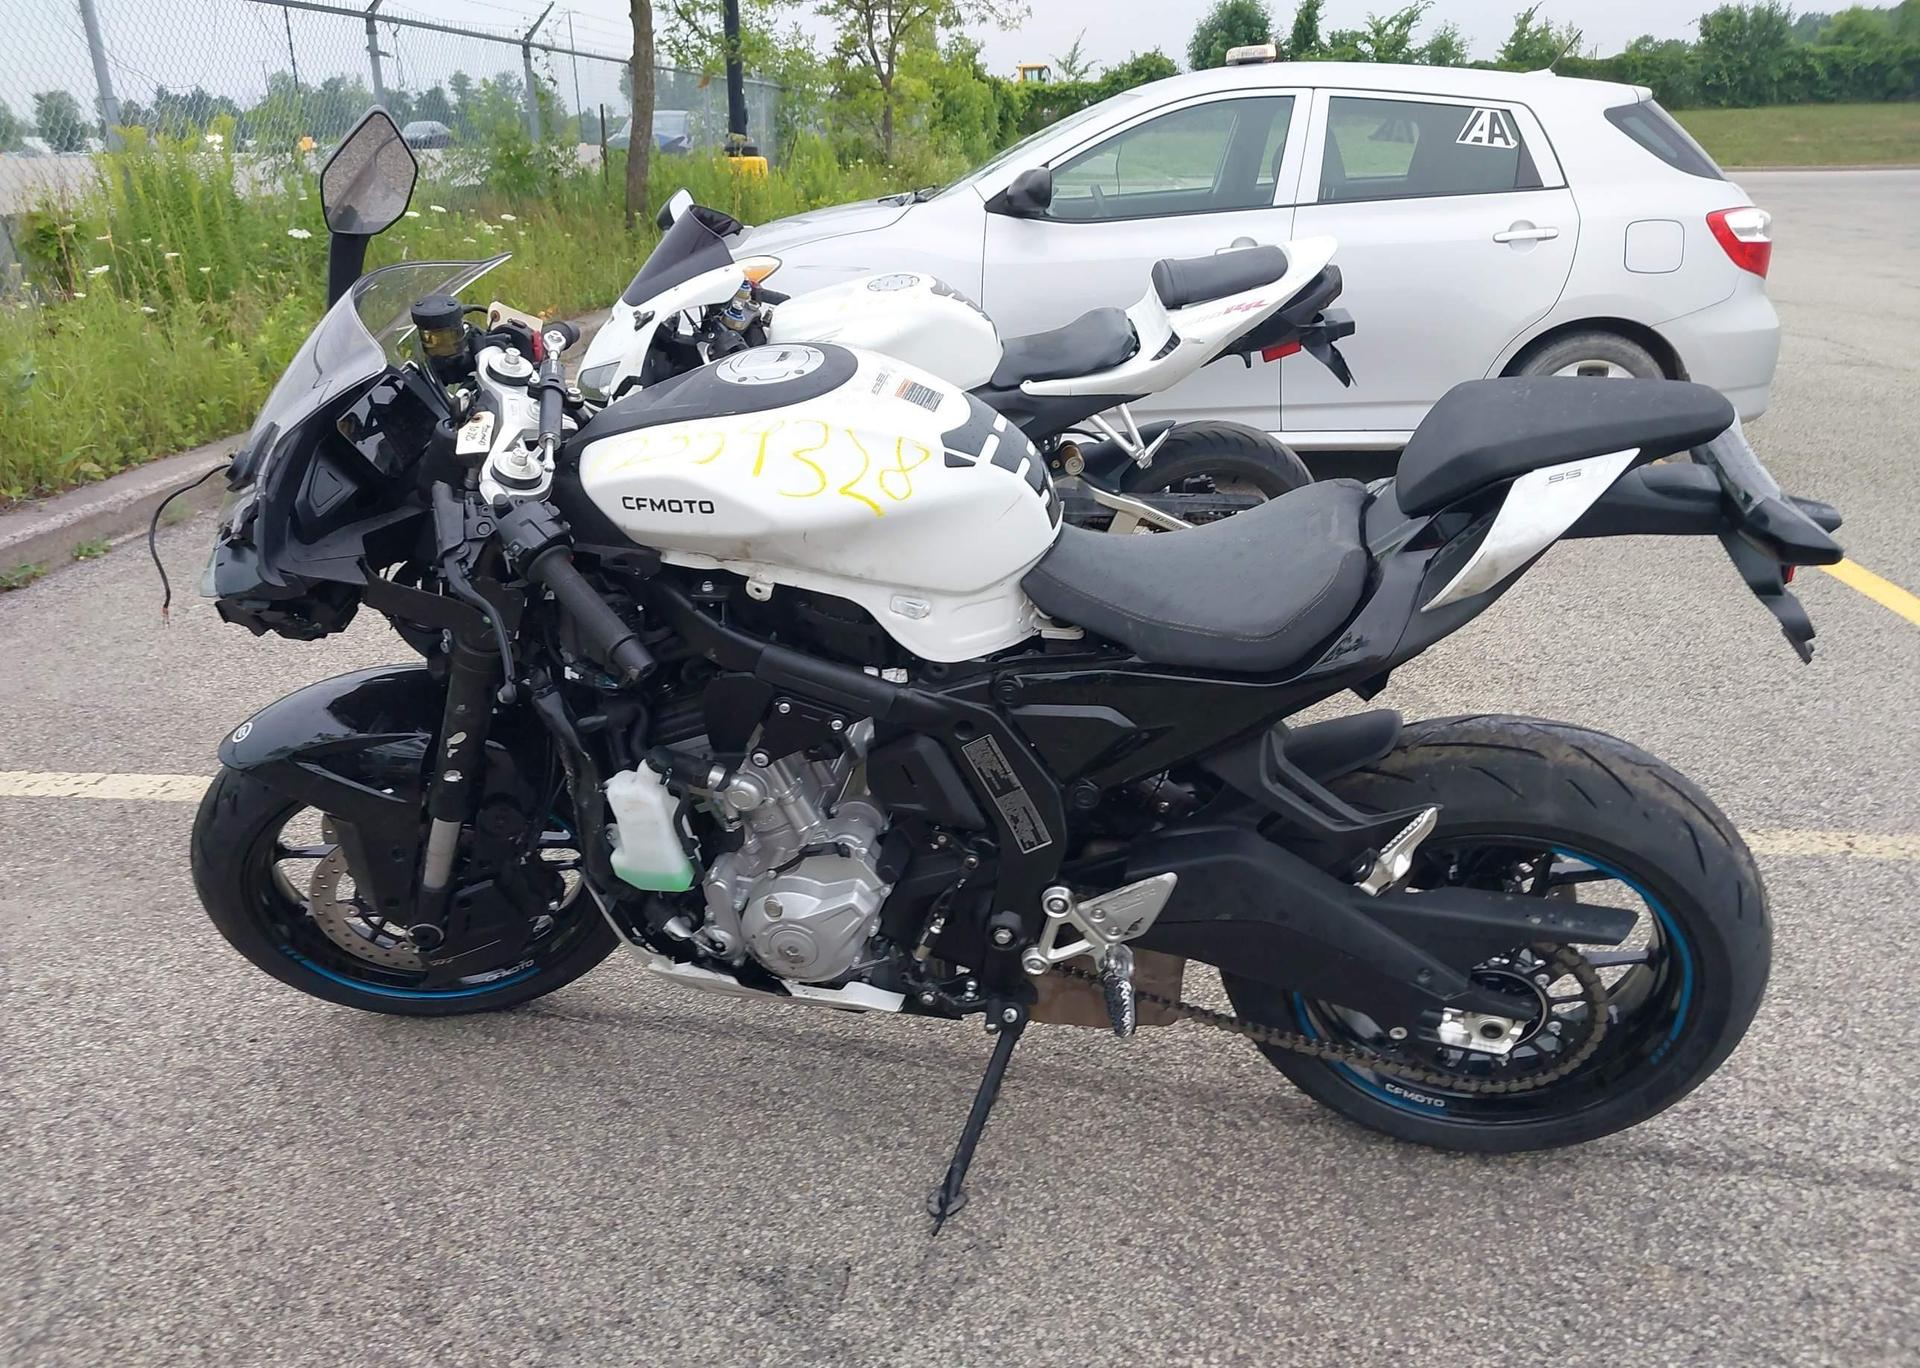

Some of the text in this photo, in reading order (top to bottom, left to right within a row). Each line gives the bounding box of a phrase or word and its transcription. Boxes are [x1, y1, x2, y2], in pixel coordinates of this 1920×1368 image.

[1546, 468, 1583, 486] SS
[622, 496, 715, 514] CFMOTO
[1384, 1082, 1446, 1107] CFMOTO
